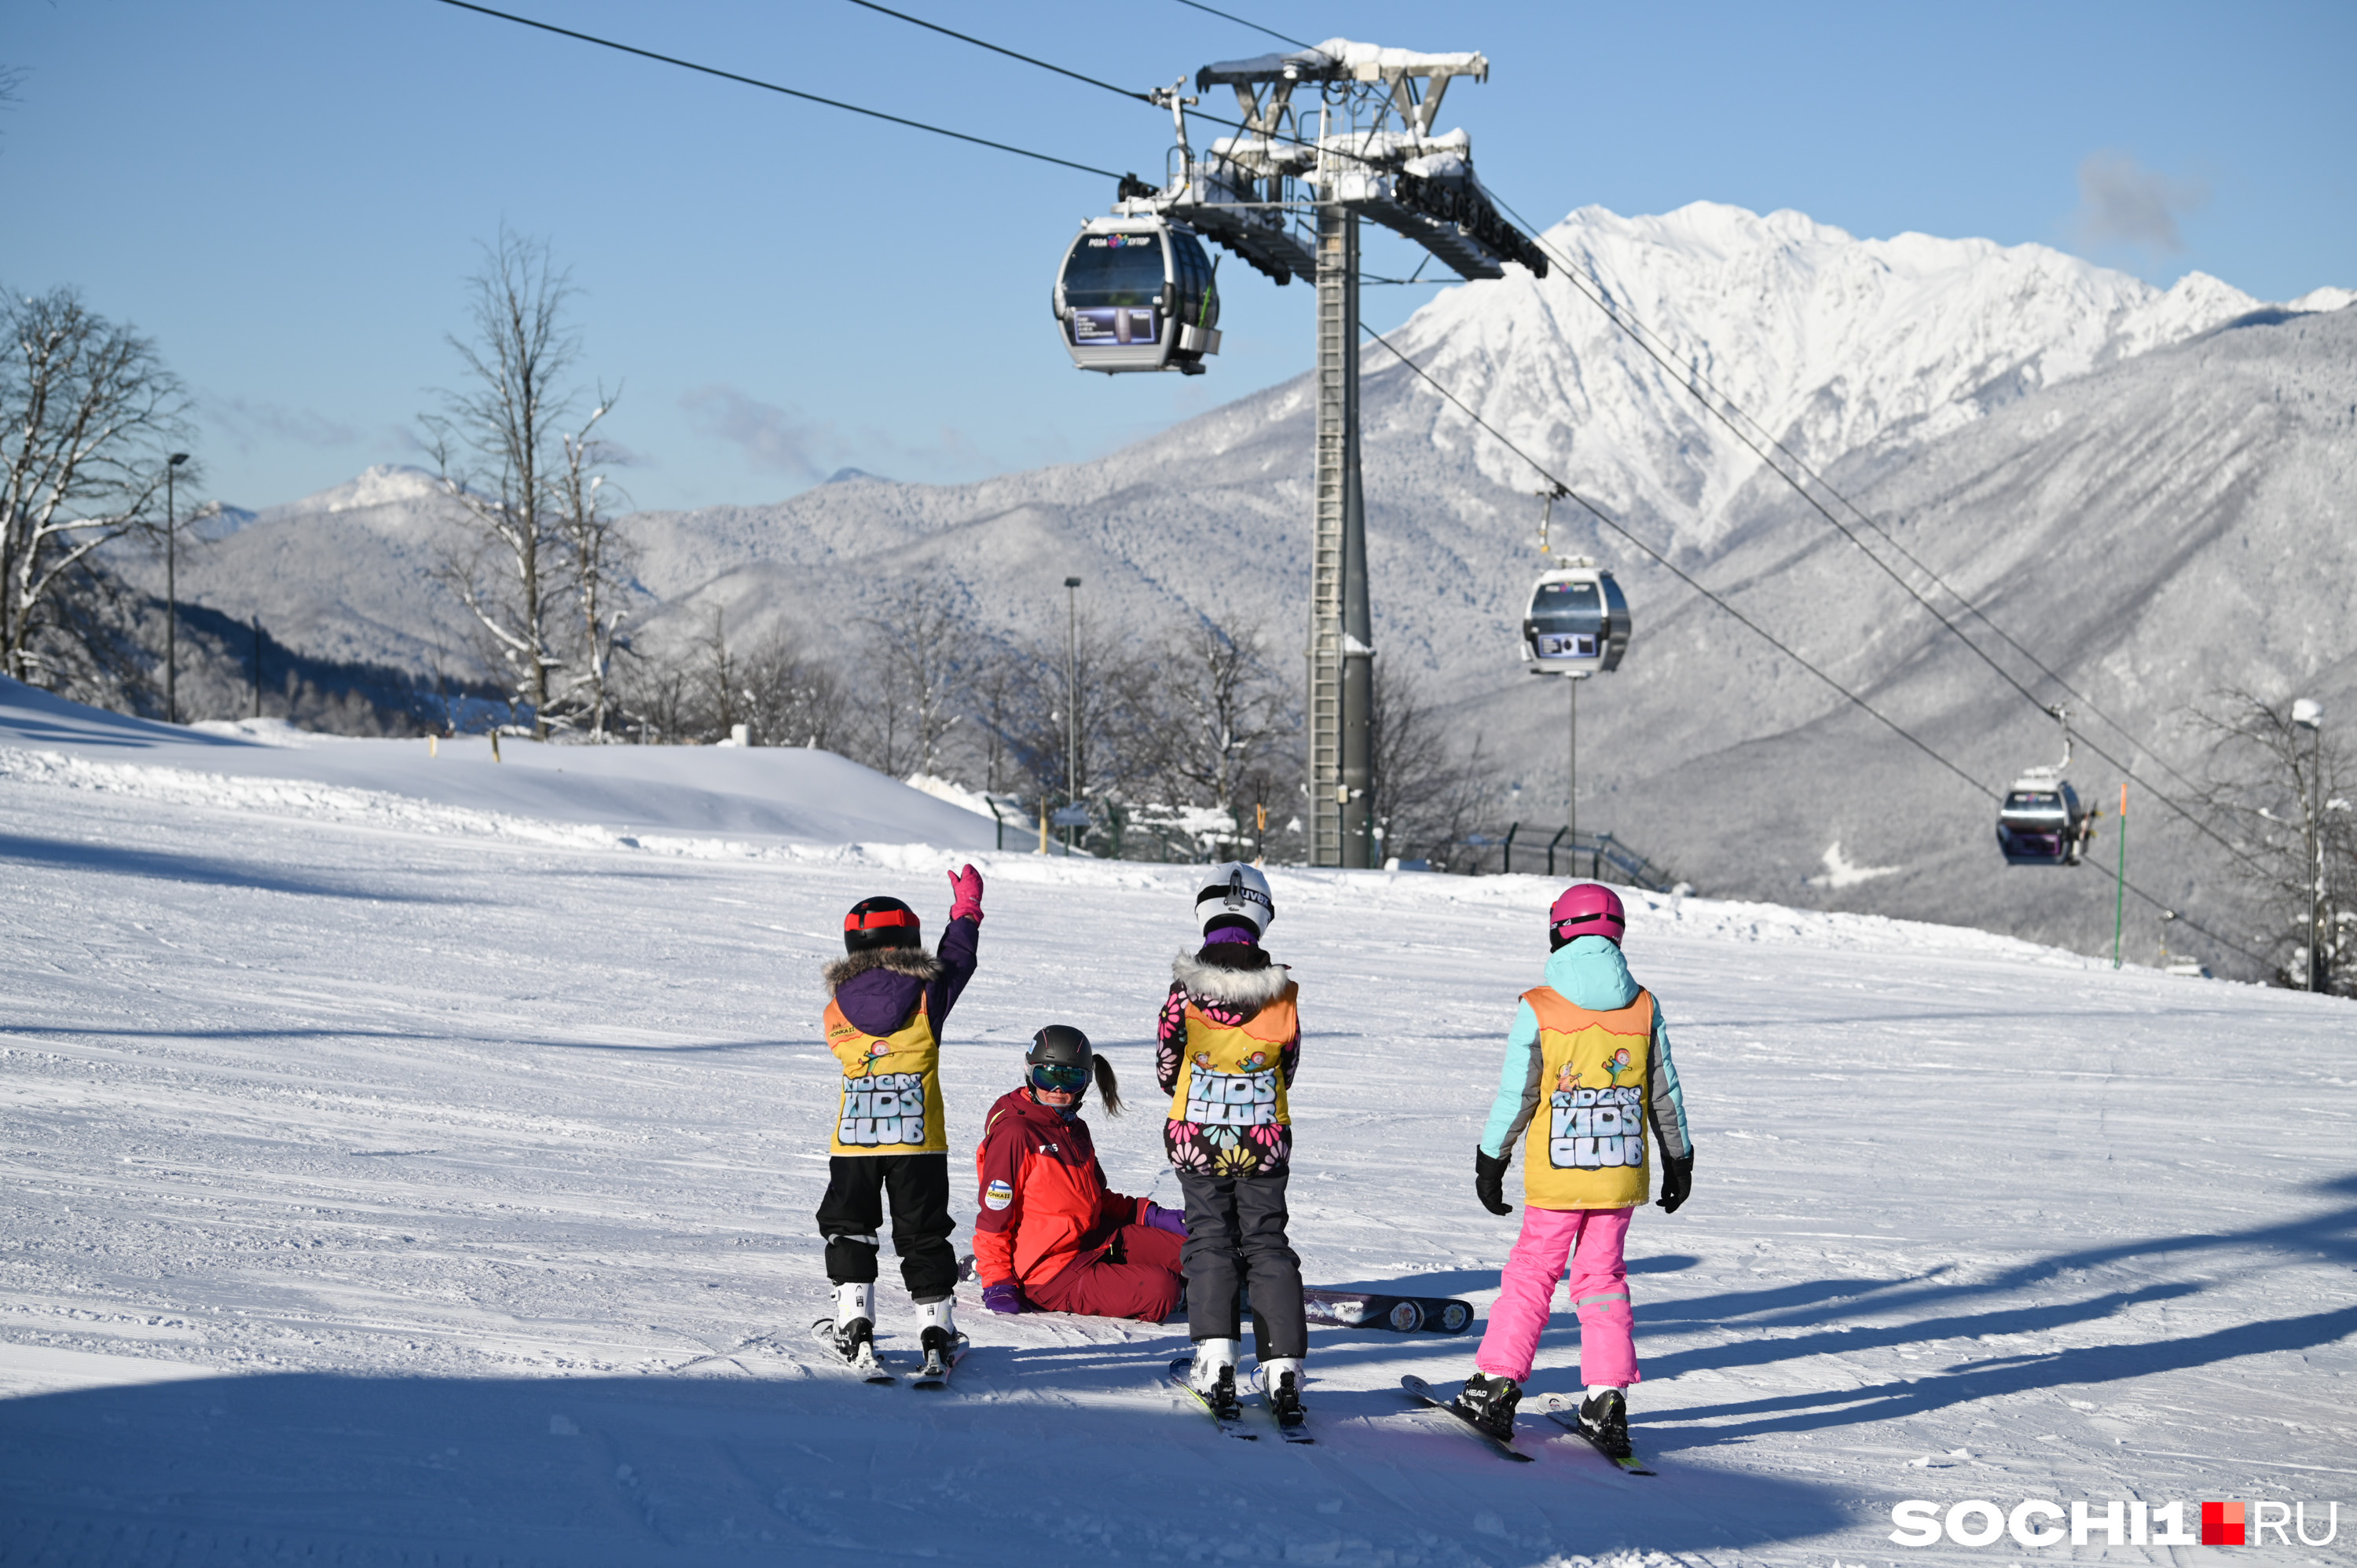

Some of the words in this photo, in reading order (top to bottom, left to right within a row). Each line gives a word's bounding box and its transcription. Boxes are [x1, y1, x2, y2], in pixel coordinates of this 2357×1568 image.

[1241, 888, 1269, 907] uvex
[841, 1089, 923, 1118] KIDS
[1188, 1073, 1277, 1105] KIDS
[1551, 1086, 1641, 1108] RIDERS
[1186, 1099, 1277, 1125] CLUB
[1551, 1105, 1642, 1138] KIDS
[838, 1116, 924, 1145] CLUB
[1550, 1136, 1643, 1167] CLUB
[1465, 1389, 1488, 1398] HEAD
